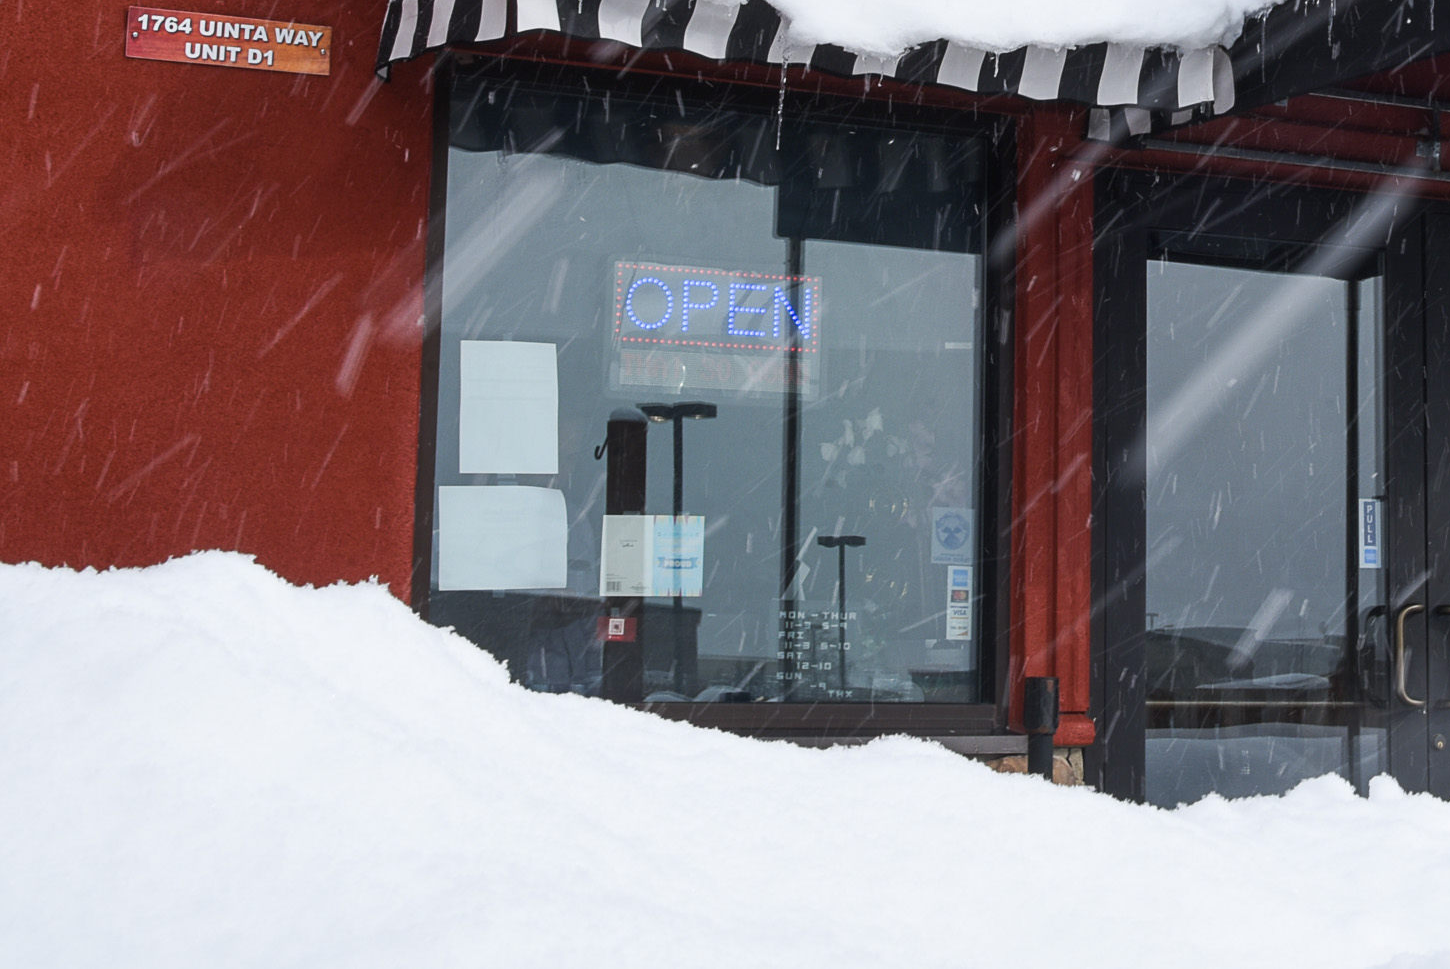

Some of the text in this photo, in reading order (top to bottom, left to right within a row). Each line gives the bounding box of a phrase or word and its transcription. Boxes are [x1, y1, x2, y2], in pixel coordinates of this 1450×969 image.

[137, 13, 324, 48] 1764 UINTA WAY
[184, 42, 275, 66] UNIT D1
[625, 277, 812, 340] OPEN
[663, 559, 692, 568] PROUD
[779, 611, 806, 619] MON
[822, 612, 857, 620] THUR
[778, 631, 804, 639] FRI
[776, 672, 803, 680] SUN
[827, 690, 853, 698] THX
